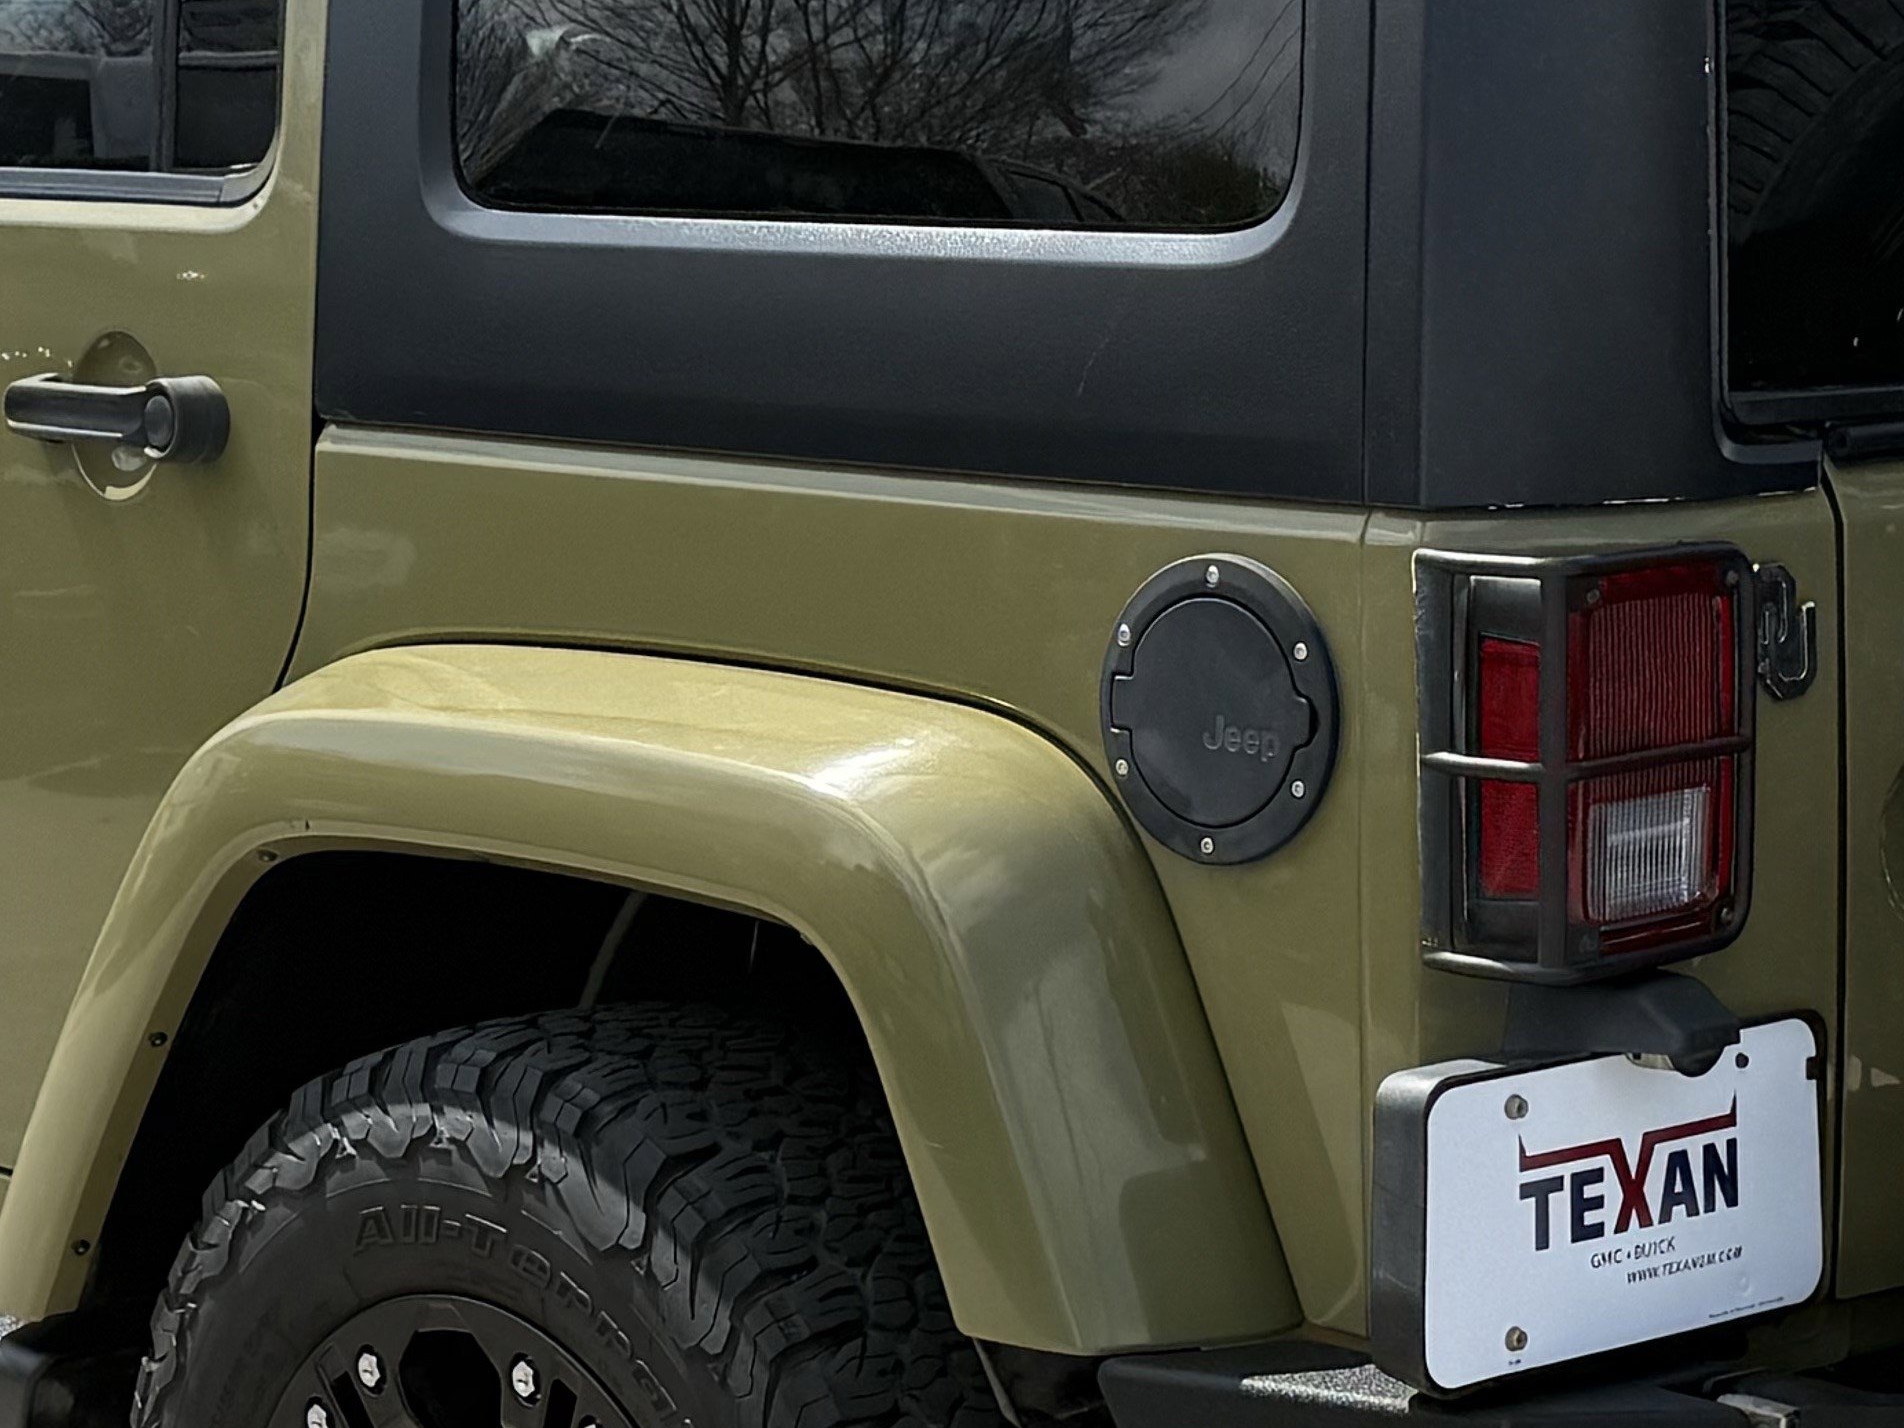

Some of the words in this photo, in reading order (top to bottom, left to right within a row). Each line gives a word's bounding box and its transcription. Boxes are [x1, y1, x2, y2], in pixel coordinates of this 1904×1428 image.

[1202, 714, 1280, 763] Jeep
[1519, 1130, 1739, 1251] TEXAN
[1590, 1248, 1623, 1269] GMC
[1634, 1236, 1676, 1261] BUICK
